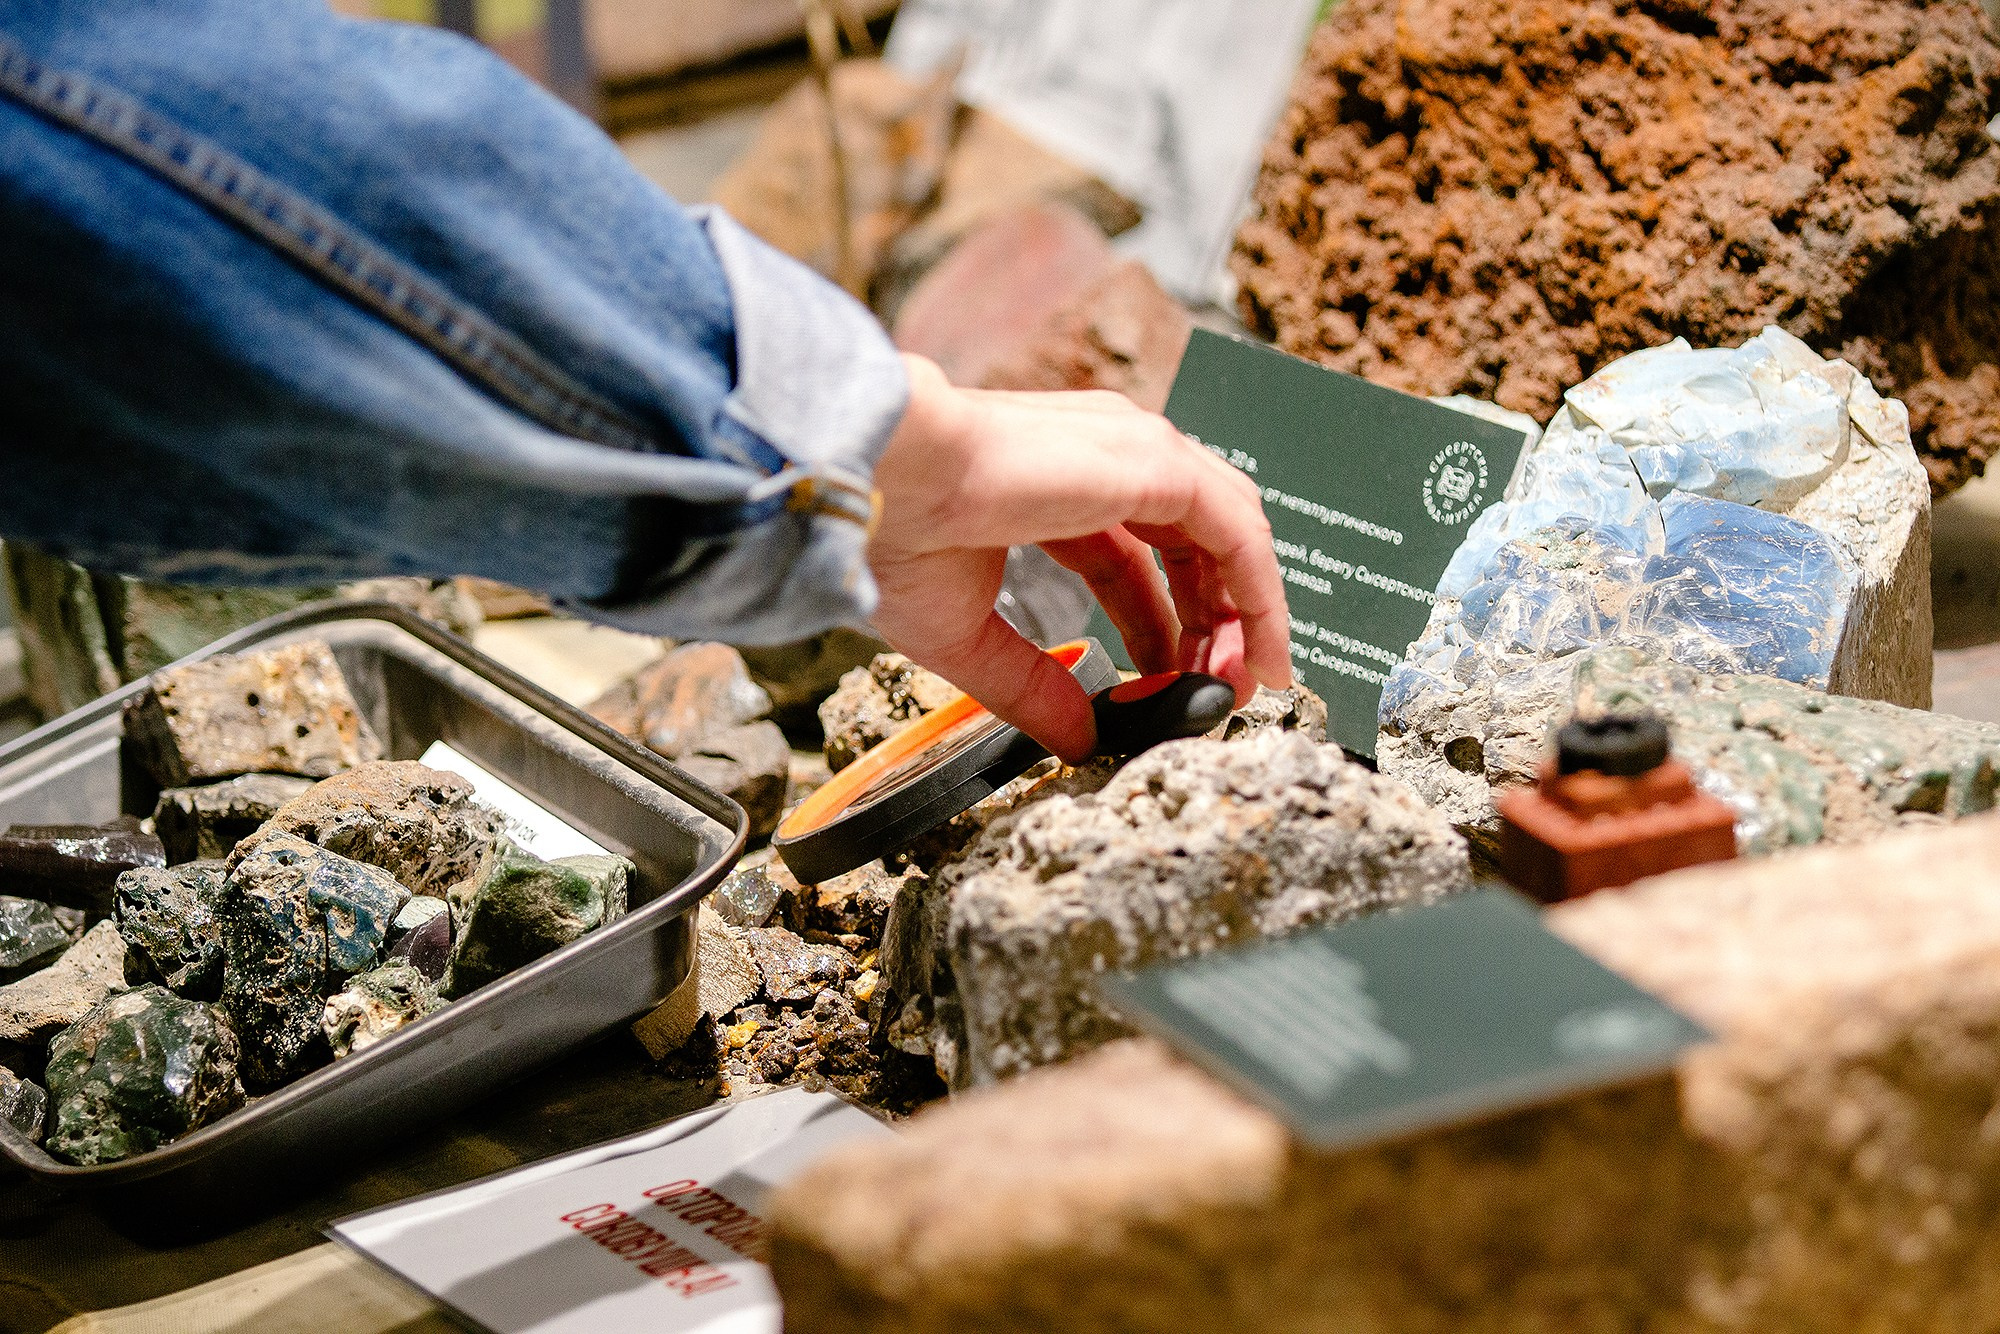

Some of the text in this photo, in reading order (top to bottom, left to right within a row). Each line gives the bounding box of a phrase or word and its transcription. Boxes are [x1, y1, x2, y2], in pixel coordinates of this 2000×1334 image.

[1279, 492, 1403, 546] металлургического
[1309, 549, 1356, 580] берегу
[1355, 565, 1437, 606] Сысертского
